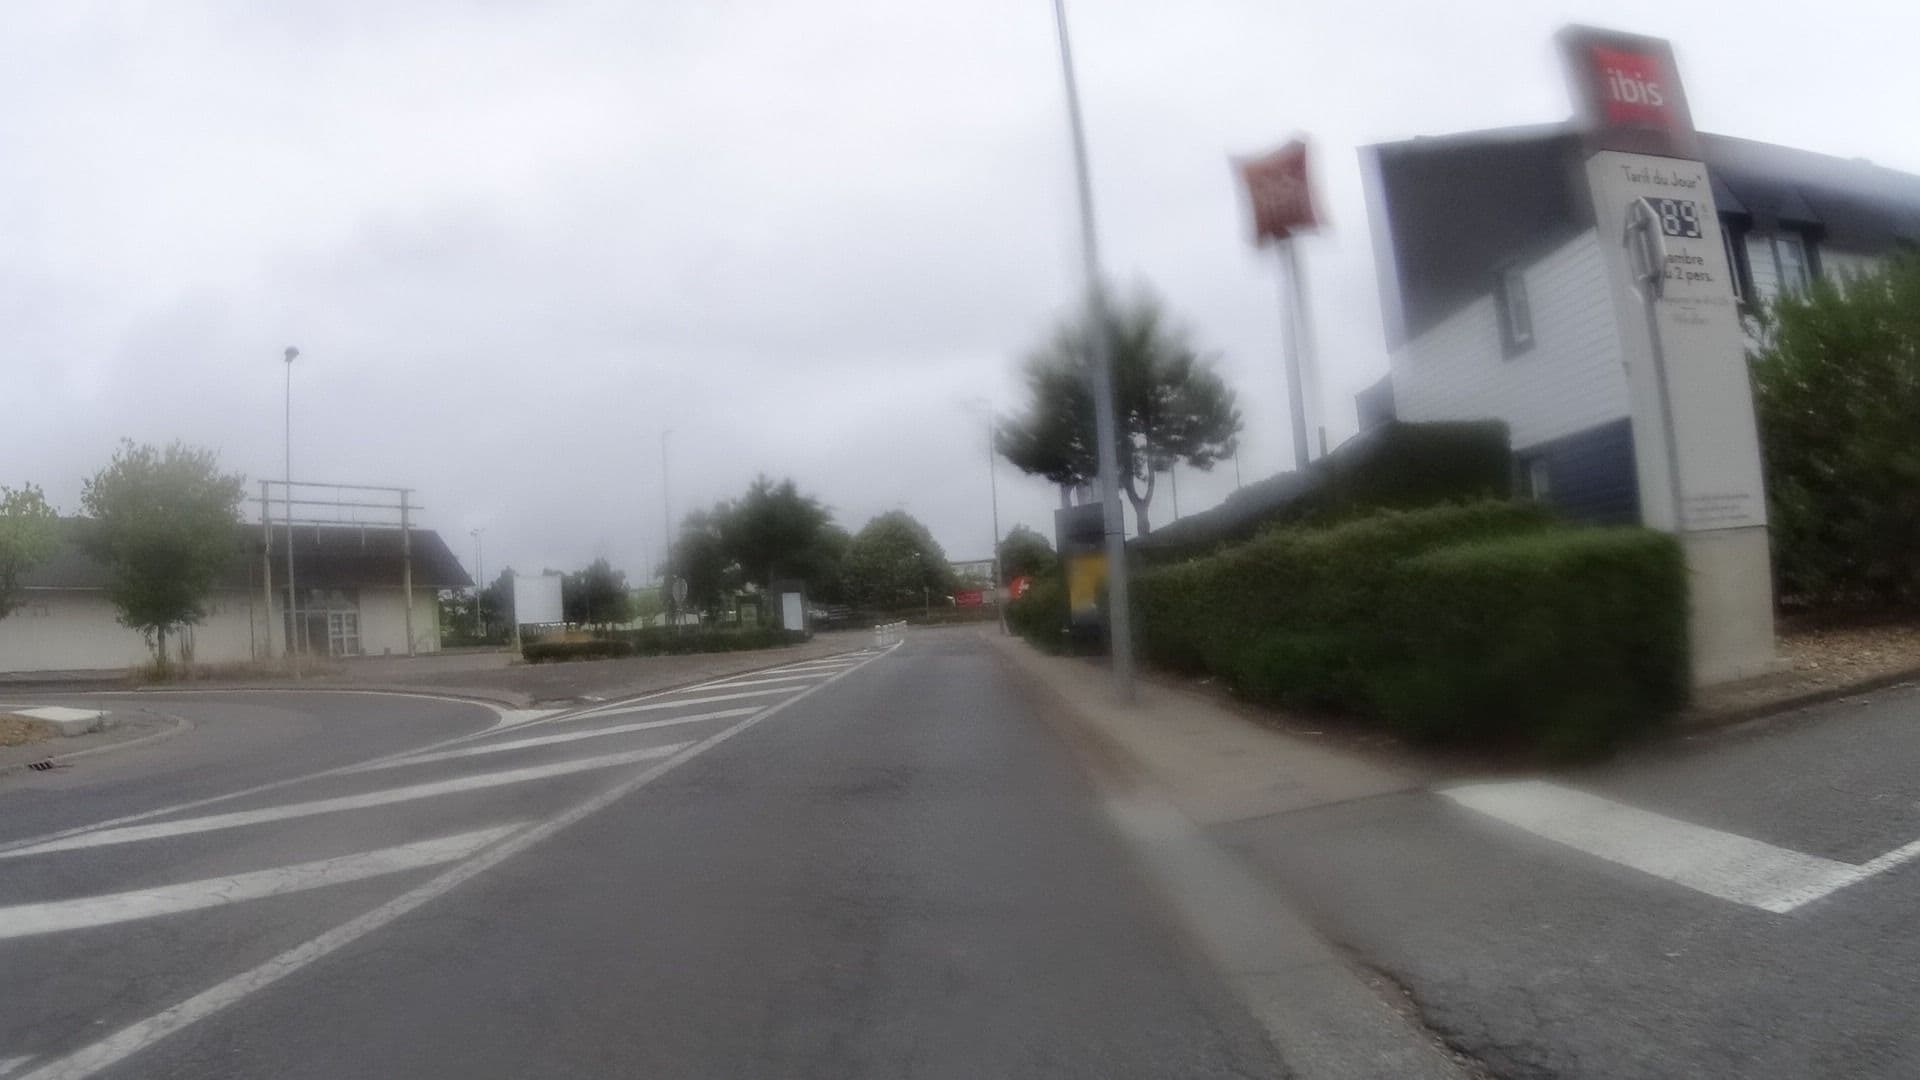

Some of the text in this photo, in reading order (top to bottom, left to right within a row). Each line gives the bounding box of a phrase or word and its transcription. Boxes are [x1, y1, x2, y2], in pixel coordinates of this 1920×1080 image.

[1606, 66, 1665, 107] ibis
[1621, 164, 1651, 185] Tarif
[1653, 167, 1669, 186] du
[1660, 199, 1700, 237] 89
[1665, 248, 1705, 266] ambre
[1674, 265, 1684, 280] 2
